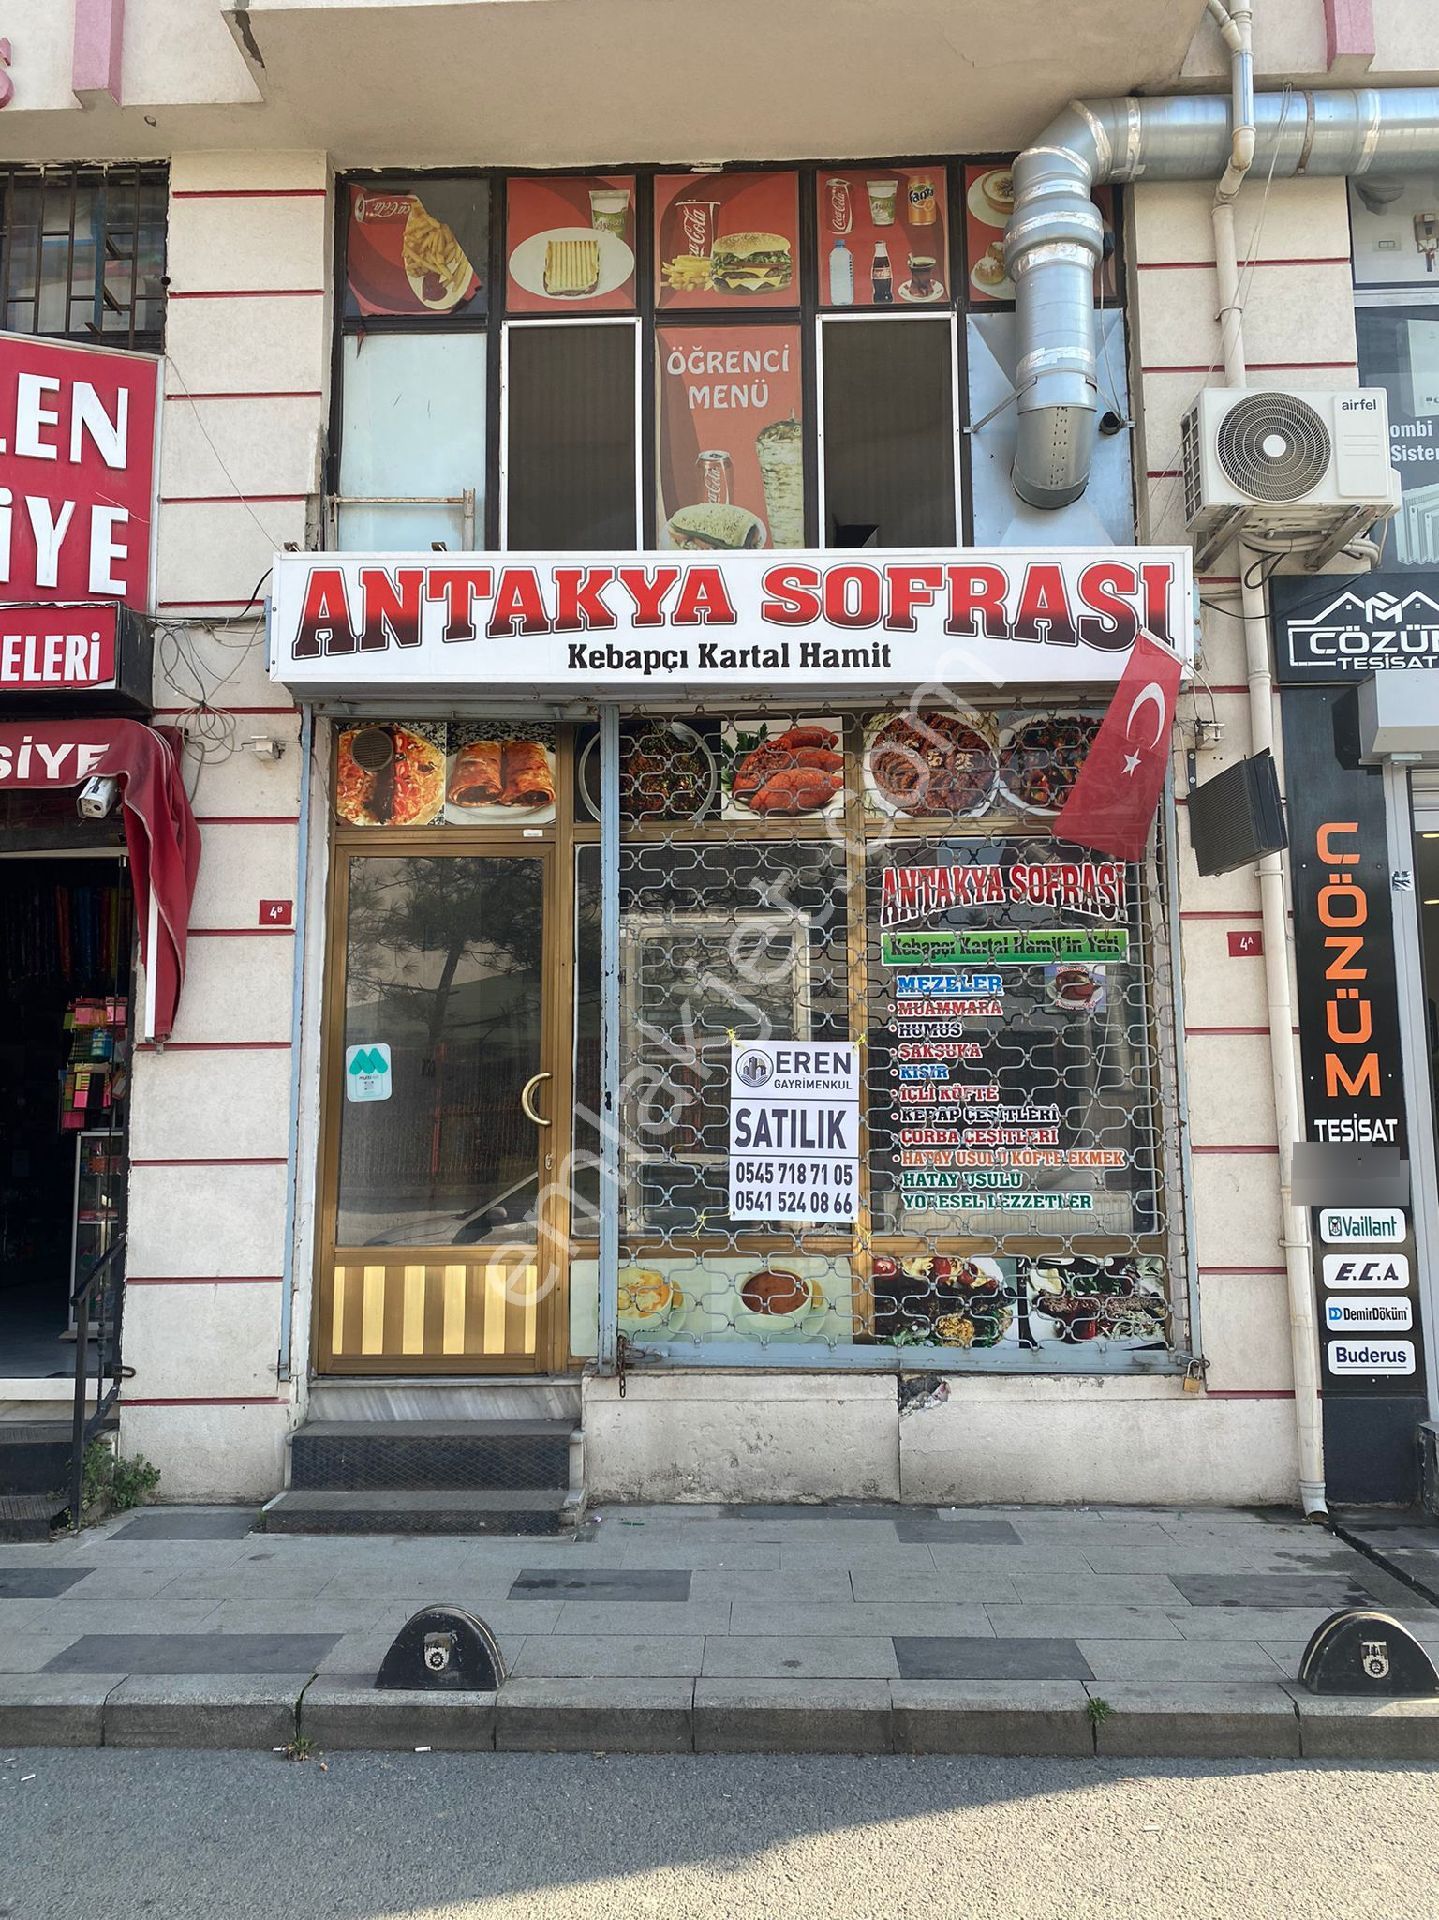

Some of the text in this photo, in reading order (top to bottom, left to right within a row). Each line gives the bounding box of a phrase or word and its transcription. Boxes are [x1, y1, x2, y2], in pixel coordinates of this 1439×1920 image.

[667, 344, 790, 375] ÖĞRENCİ
[689, 379, 769, 410] MENÜ
[1341, 399, 1377, 411] airfel
[0, 372, 129, 470] EN
[1389, 420, 1433, 438] ombi
[292, 560, 1175, 661] ANTAKYA SOFRASI
[567, 641, 892, 676] Kebapçı Kartal Hamit
[880, 861, 1129, 928] ANTAKYA SOFRASI
[960, 937, 1009, 955] Kartal
[1087, 935, 1119, 954] Yeri
[897, 975, 1003, 995] MEZELER
[897, 1000, 1004, 1017] MUAMMARA
[897, 1021, 963, 1038] HUMUS
[776, 1051, 851, 1075] EREN
[899, 1064, 950, 1080] KISIR
[774, 1077, 853, 1090] GAYRİMENKUL
[734, 1107, 848, 1150] SATILIK
[1313, 1113, 1399, 1142] TESİSAT
[1067, 1149, 1126, 1167] EKMEK
[735, 1162, 853, 1185] 0545 718 71 05
[902, 1171, 961, 1188] HATAY
[735, 1191, 853, 1214] 0541 524 08 66
[1343, 1215, 1397, 1237] Vaillant
[1343, 1306, 1408, 1321] DemirDöküm
[1336, 1346, 1407, 1363] Buderus
